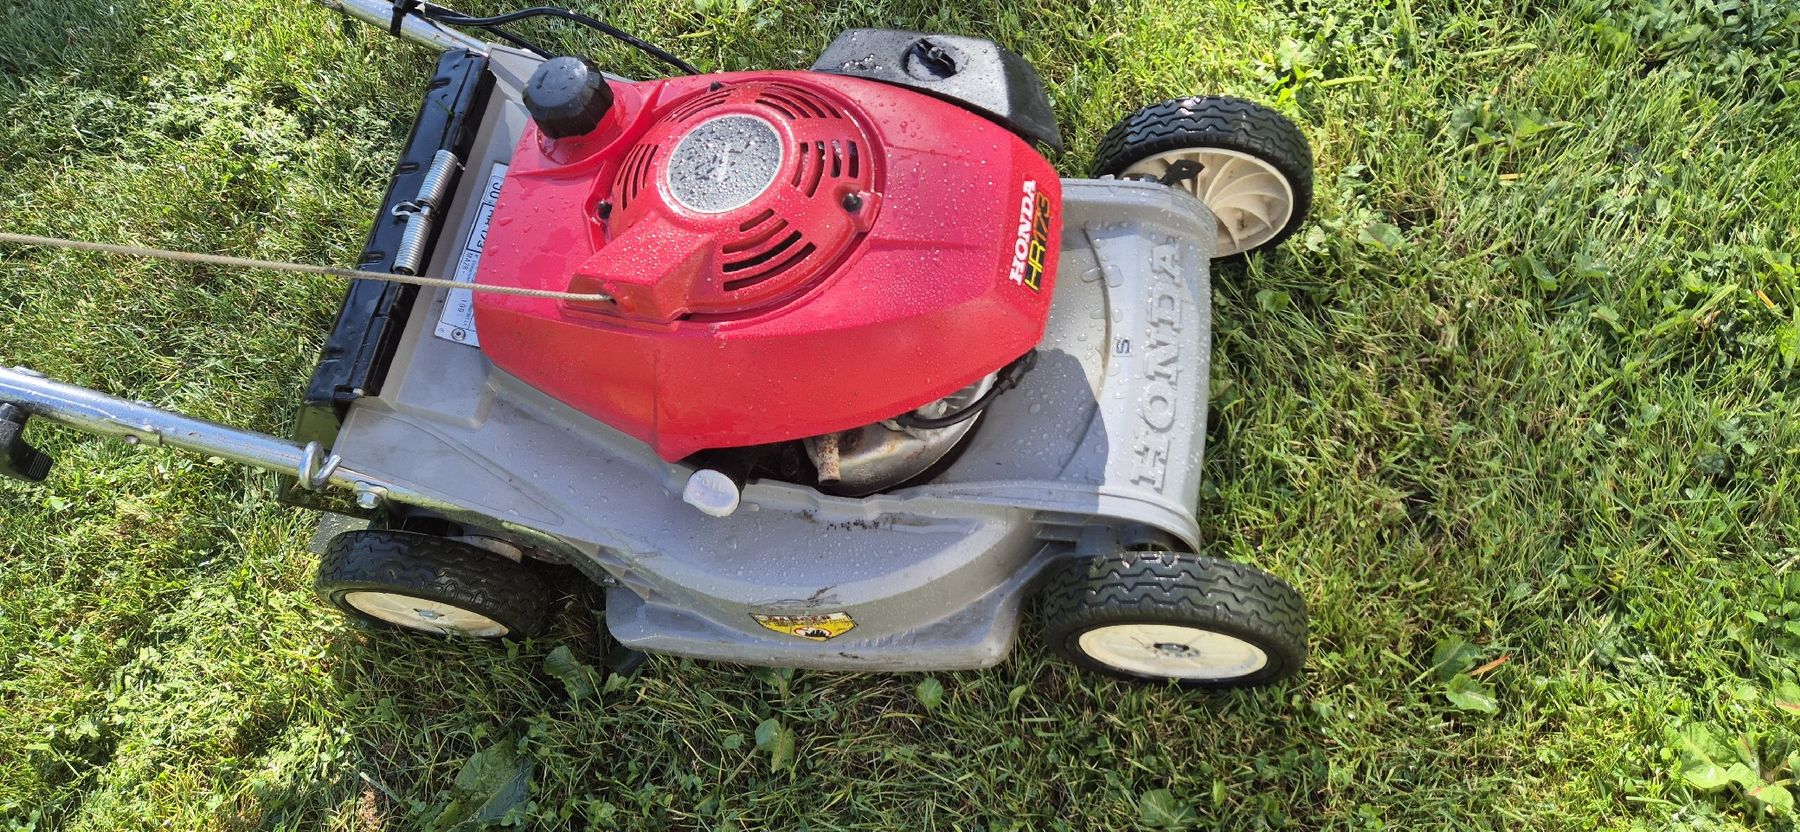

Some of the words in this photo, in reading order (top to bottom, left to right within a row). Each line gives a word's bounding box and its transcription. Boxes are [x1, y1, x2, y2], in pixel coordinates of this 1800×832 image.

[1009, 180, 1036, 286] HONDA
[1024, 191, 1050, 291] HR173
[1116, 338, 1131, 354] S
[1130, 238, 1182, 494] HONDA
